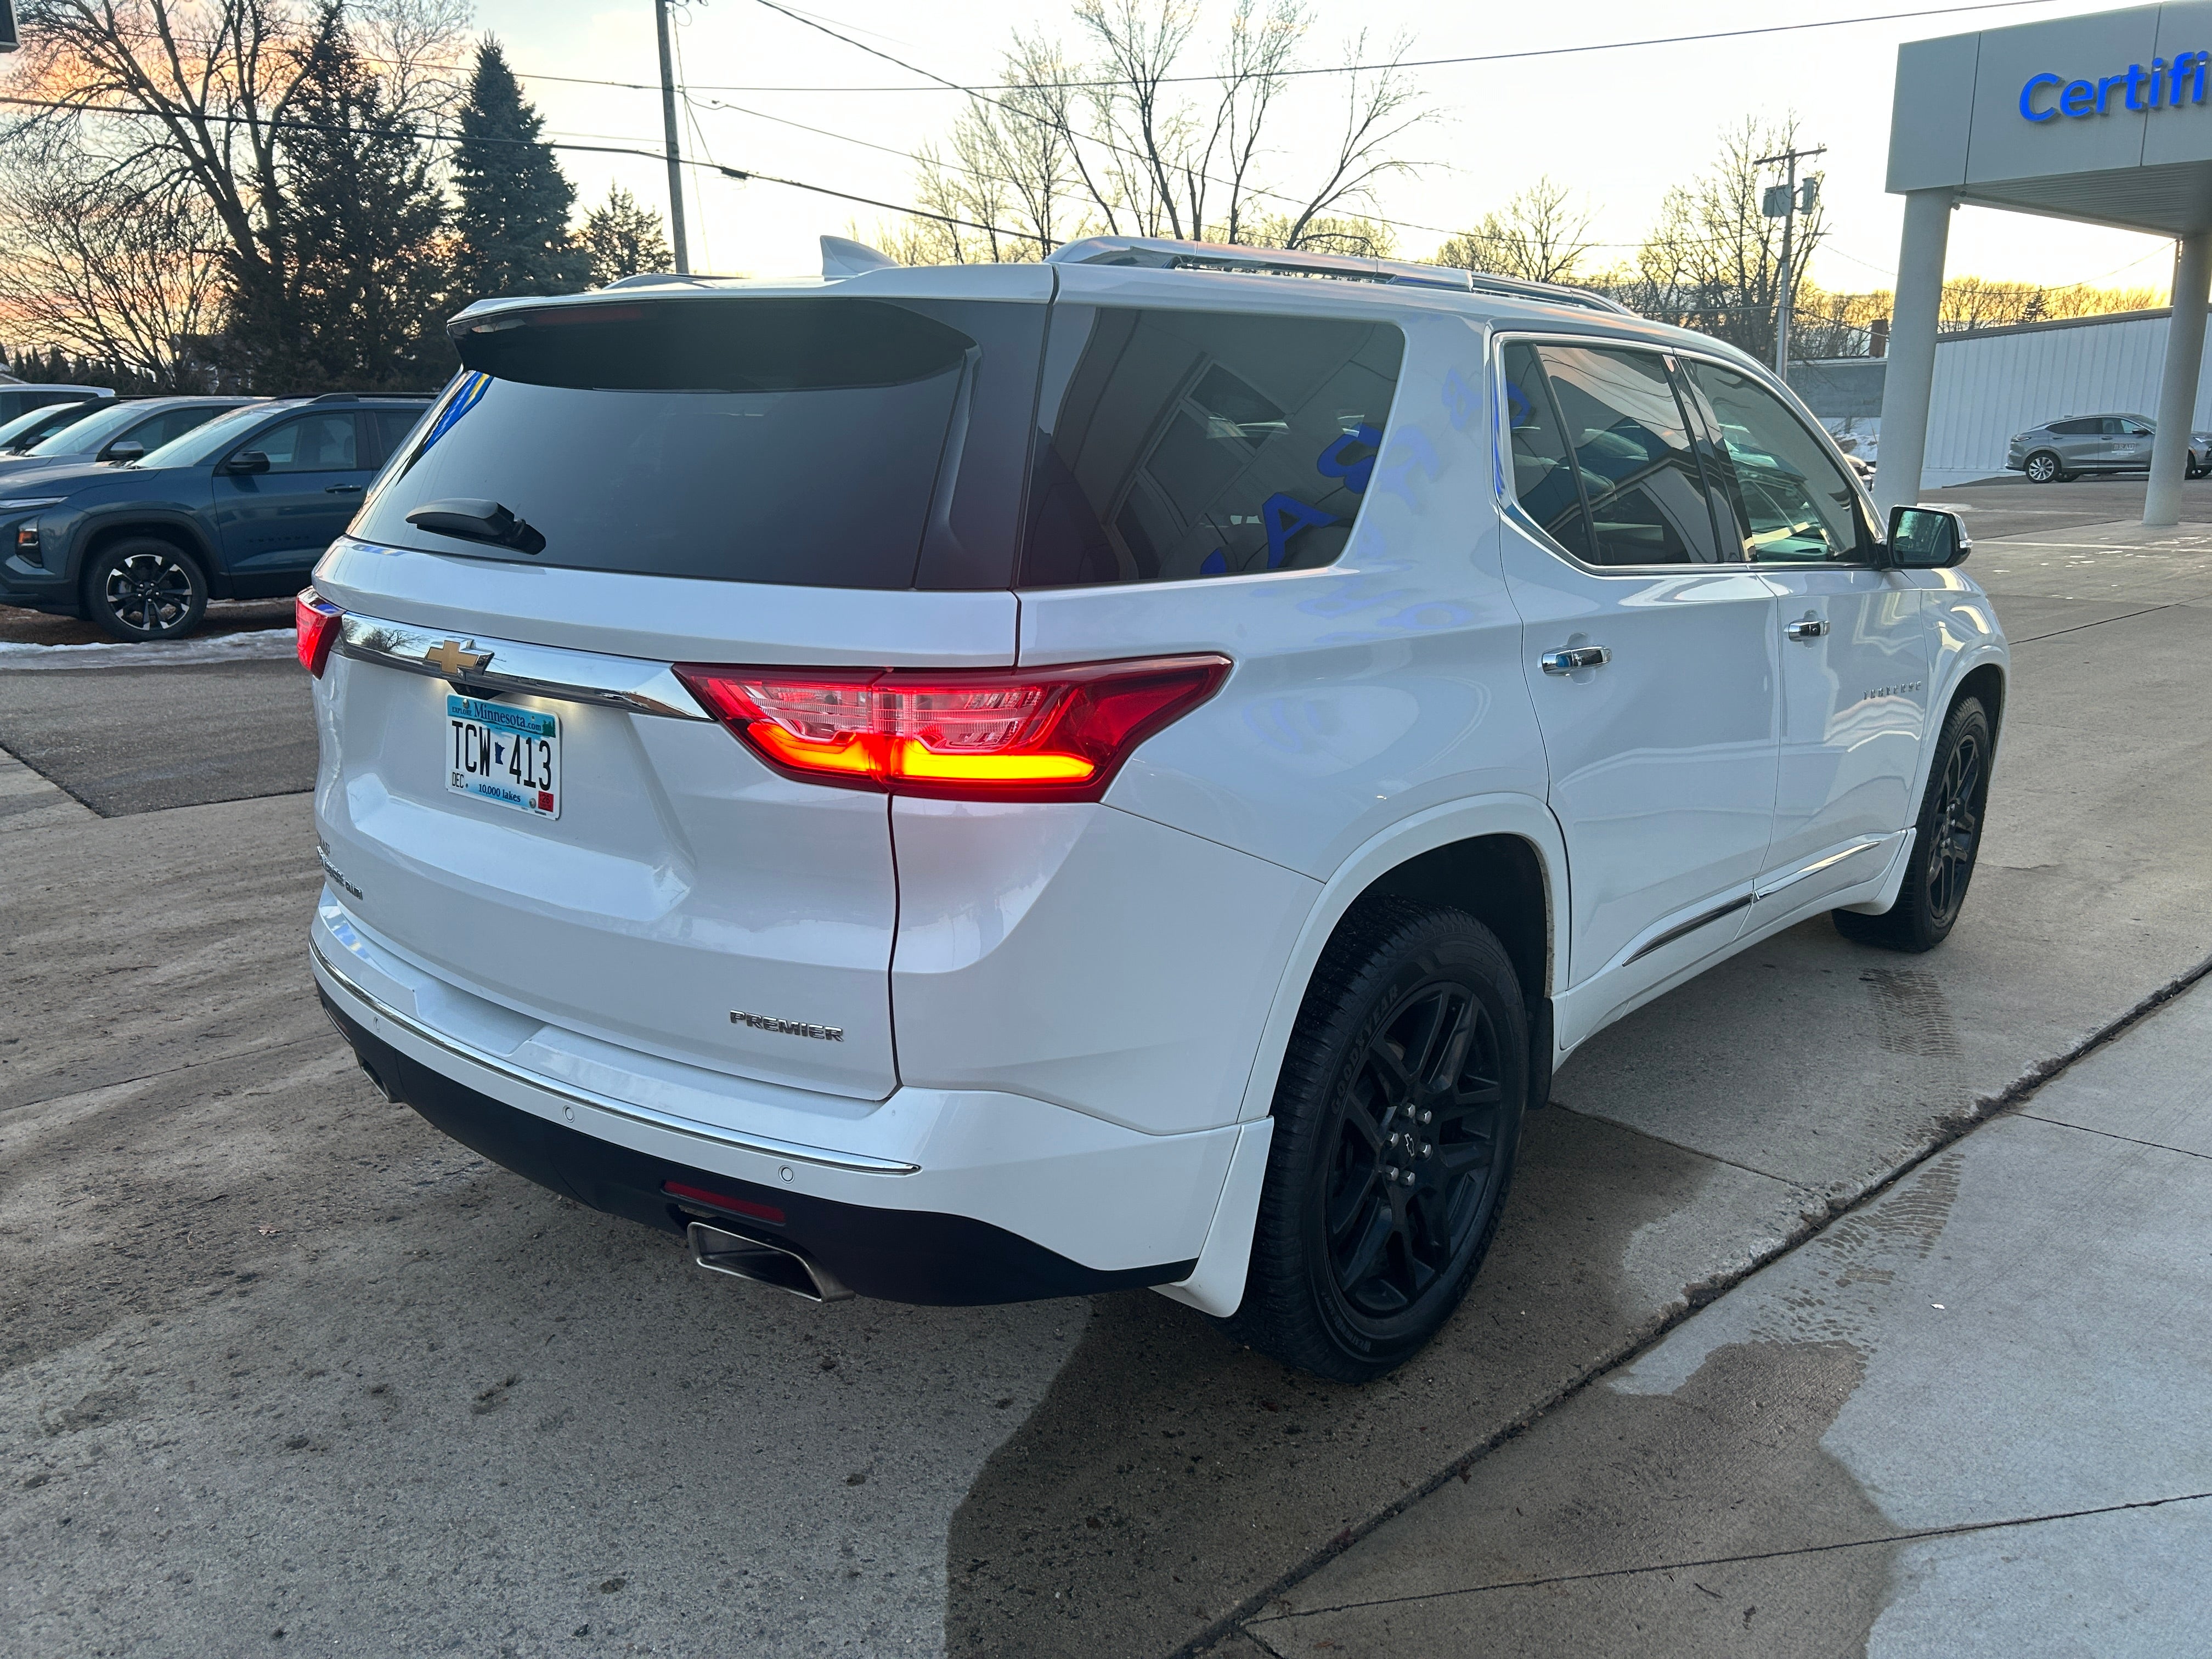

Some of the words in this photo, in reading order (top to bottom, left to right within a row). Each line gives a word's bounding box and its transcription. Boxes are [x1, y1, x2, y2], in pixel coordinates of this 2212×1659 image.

[452, 771, 464, 788] DEC
[478, 783, 500, 797] 10,000
[503, 789, 521, 802] lakes
[730, 1009, 845, 1042] PREMIER
